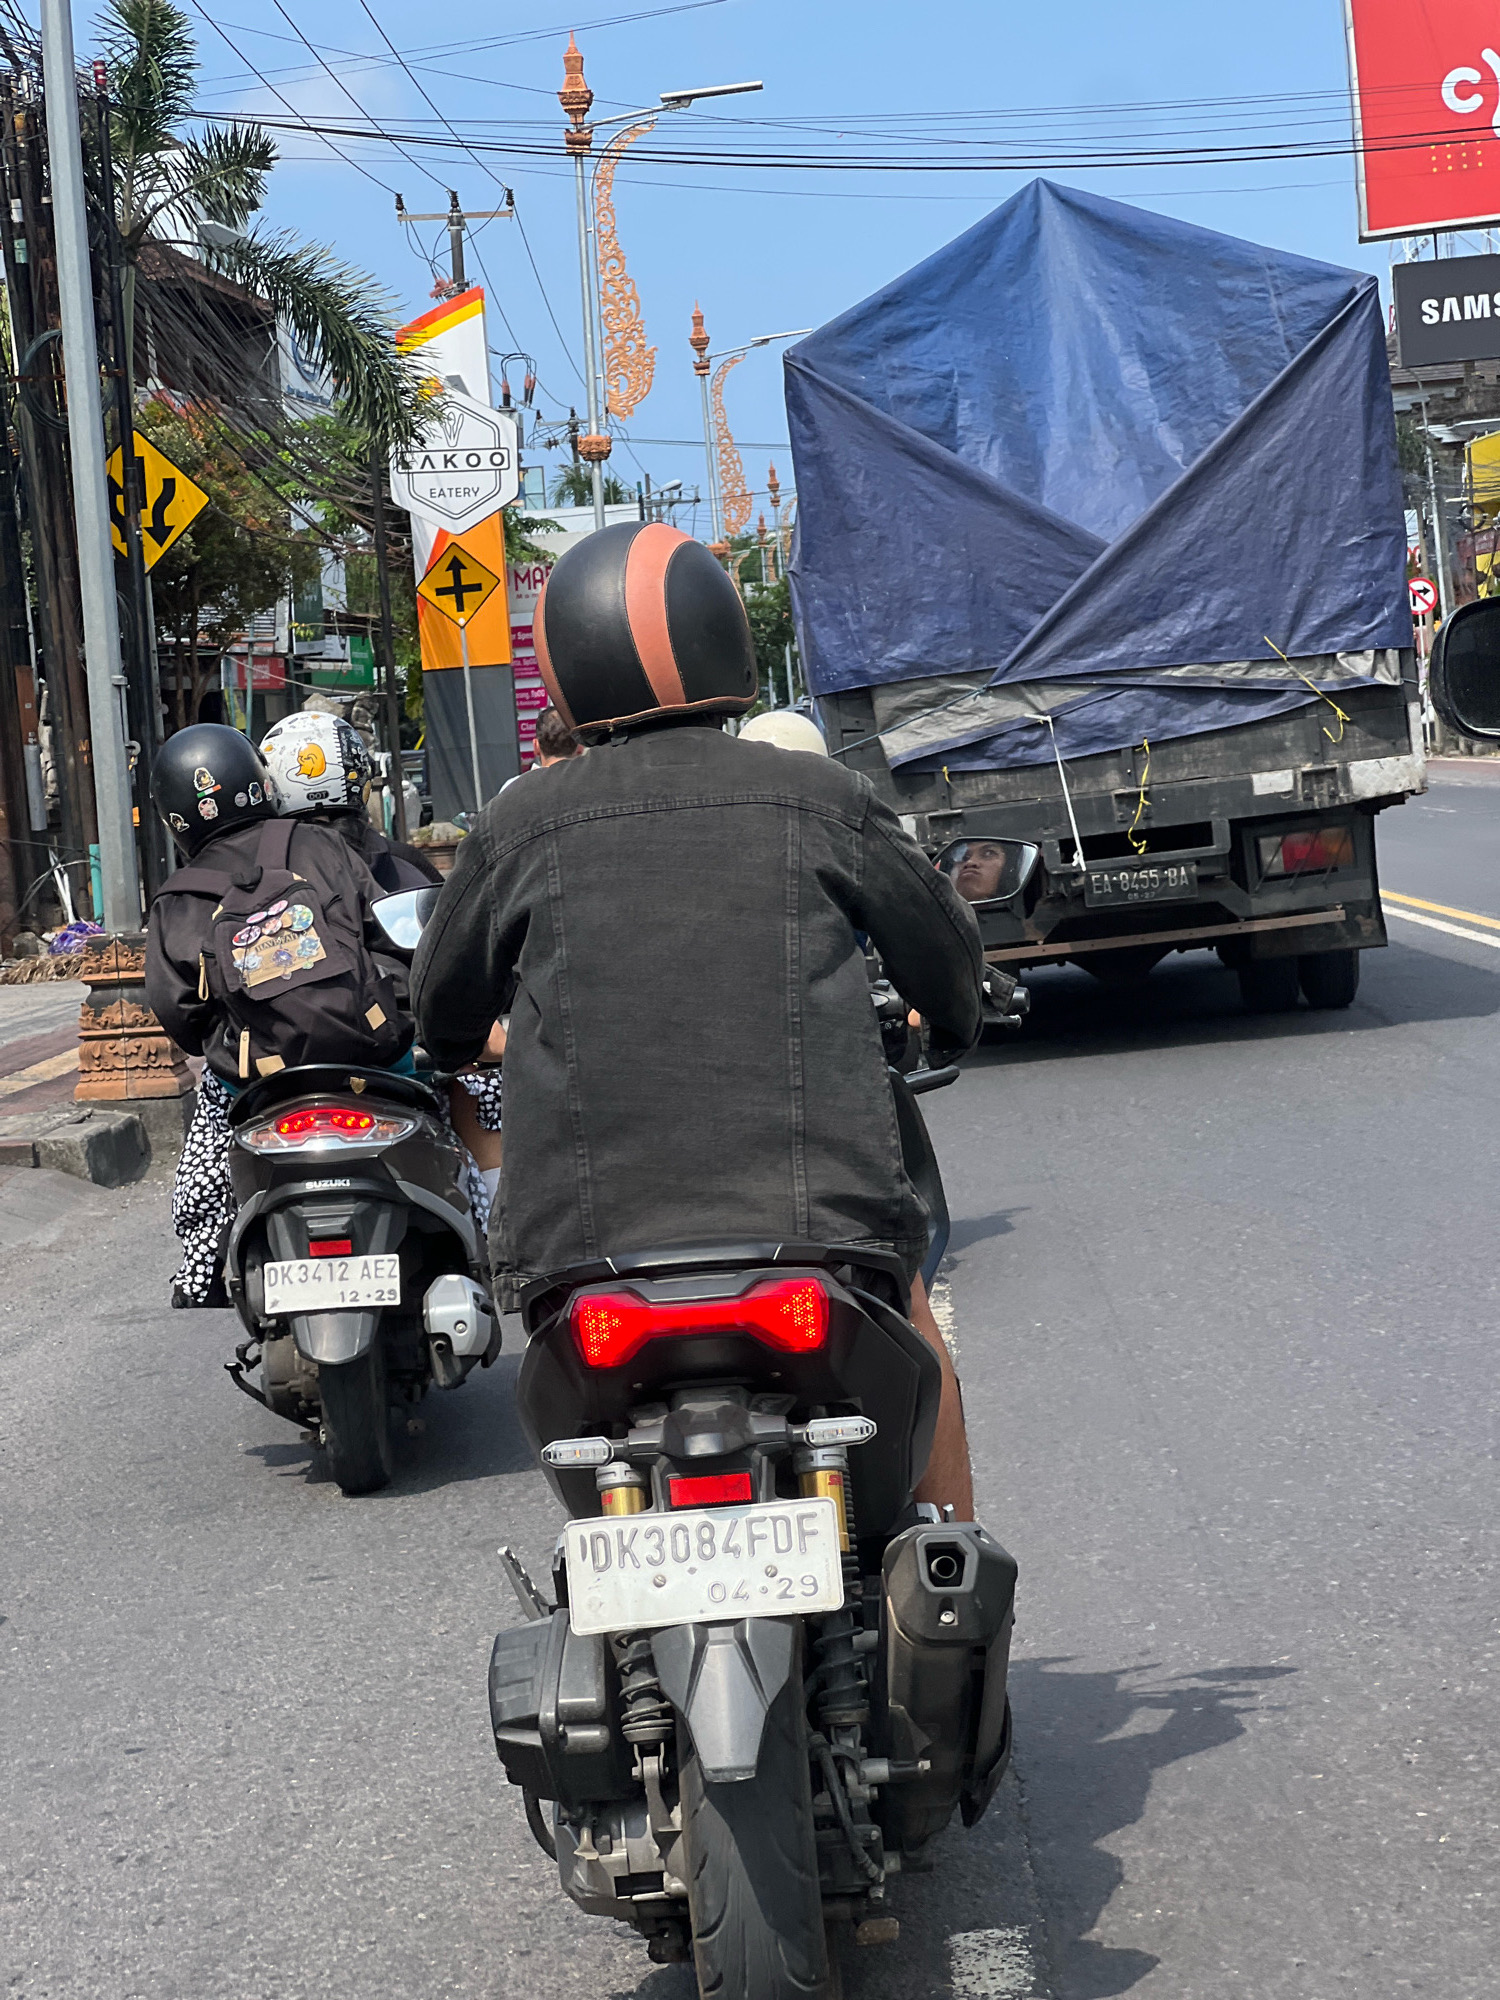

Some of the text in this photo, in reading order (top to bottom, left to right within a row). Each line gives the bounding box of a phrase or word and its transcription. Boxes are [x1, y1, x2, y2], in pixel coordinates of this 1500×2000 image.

[429, 487, 480, 498] EATERY
[308, 791, 328, 800] DOT
[1091, 865, 1189, 894] EA 8455 BA
[305, 1179, 350, 1189] SUZUKI
[360, 1258, 398, 1280] AEZ
